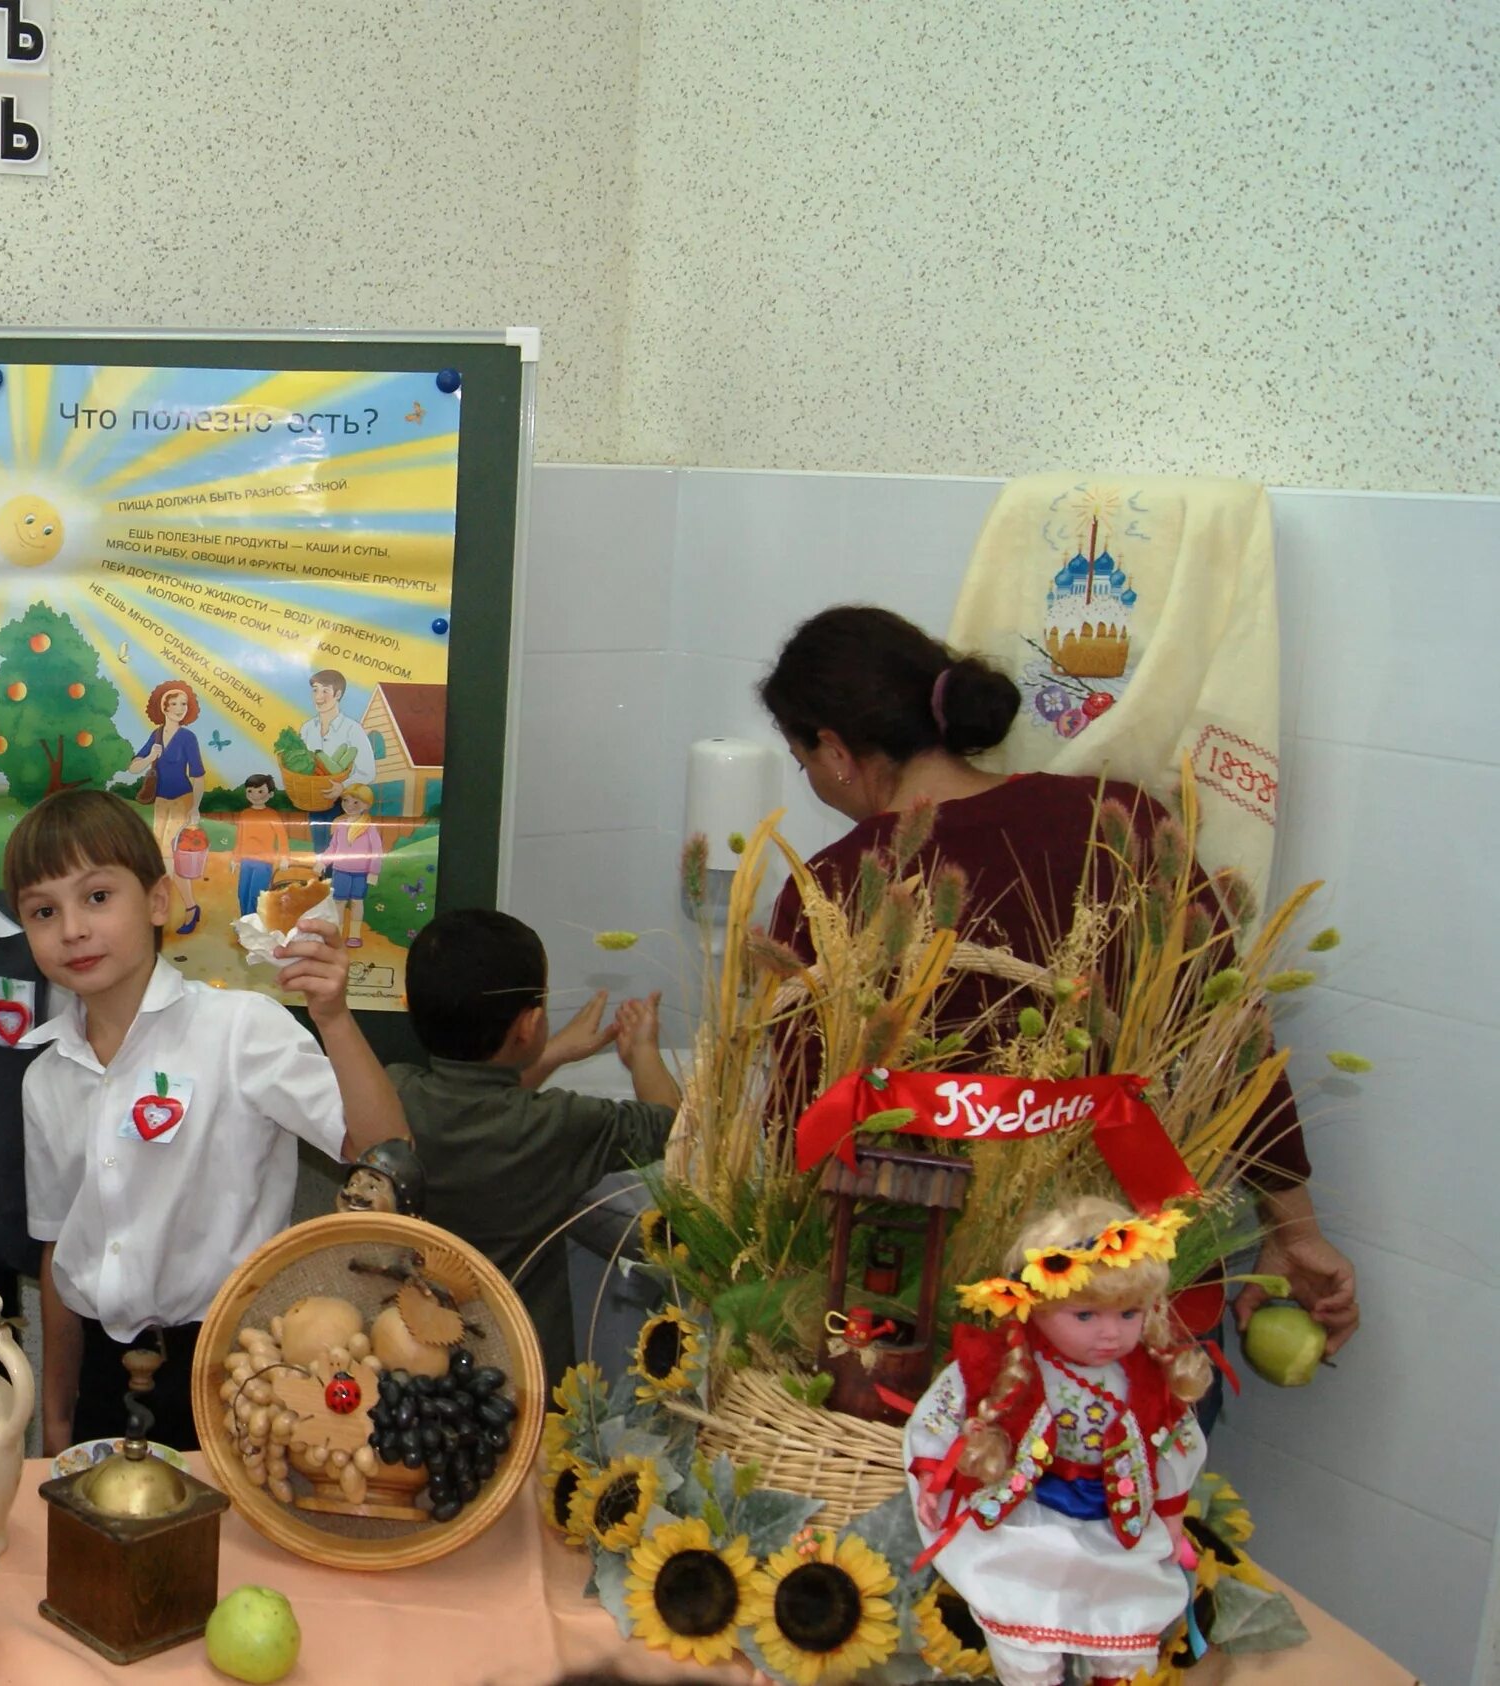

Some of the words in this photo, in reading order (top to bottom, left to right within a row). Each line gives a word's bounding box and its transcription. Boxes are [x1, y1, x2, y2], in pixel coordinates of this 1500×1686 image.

[1, 97, 40, 160] Ь
[59, 402, 117, 430] Что
[132, 408, 272, 433] полезно
[287, 408, 379, 435] есть?
[118, 500, 153, 513] ПИЩА
[156, 494, 207, 510] ДОЛЖНА
[209, 490, 242, 504] БЫТЬ
[106, 539, 141, 552] МЯСО
[143, 545, 152, 553] И
[155, 546, 189, 559] РЫБУ,
[191, 550, 235, 564] ОВОЩИ
[238, 558, 246, 566] И
[249, 558, 299, 574] ФРУКТЫ,
[302, 565, 369, 582] МОЛОЧНЫЕ
[129, 528, 153, 540] ЕШЬ
[157, 531, 221, 545] ПОЛЕЗНЫЕ
[225, 535, 288, 549] ПРОДУКТЫ
[306, 542, 339, 553] КАШИ
[342, 545, 350, 554] И
[89, 582, 105, 597] НЕ
[104, 592, 127, 612] ЕШЬ
[127, 608, 164, 637] МНОГО
[101, 559, 125, 573] ПЕЙ
[127, 566, 202, 594] ДОСТАТОЧНО
[205, 586, 268, 612] ЖИДКОСТИ
[284, 608, 315, 625] ВОДУ
[146, 585, 196, 610] МОЛОКО,
[343, 649, 351, 659] С
[160, 646, 207, 690] ЖАРЕНЫХ
[934, 1080, 1096, 1137] Кубань
